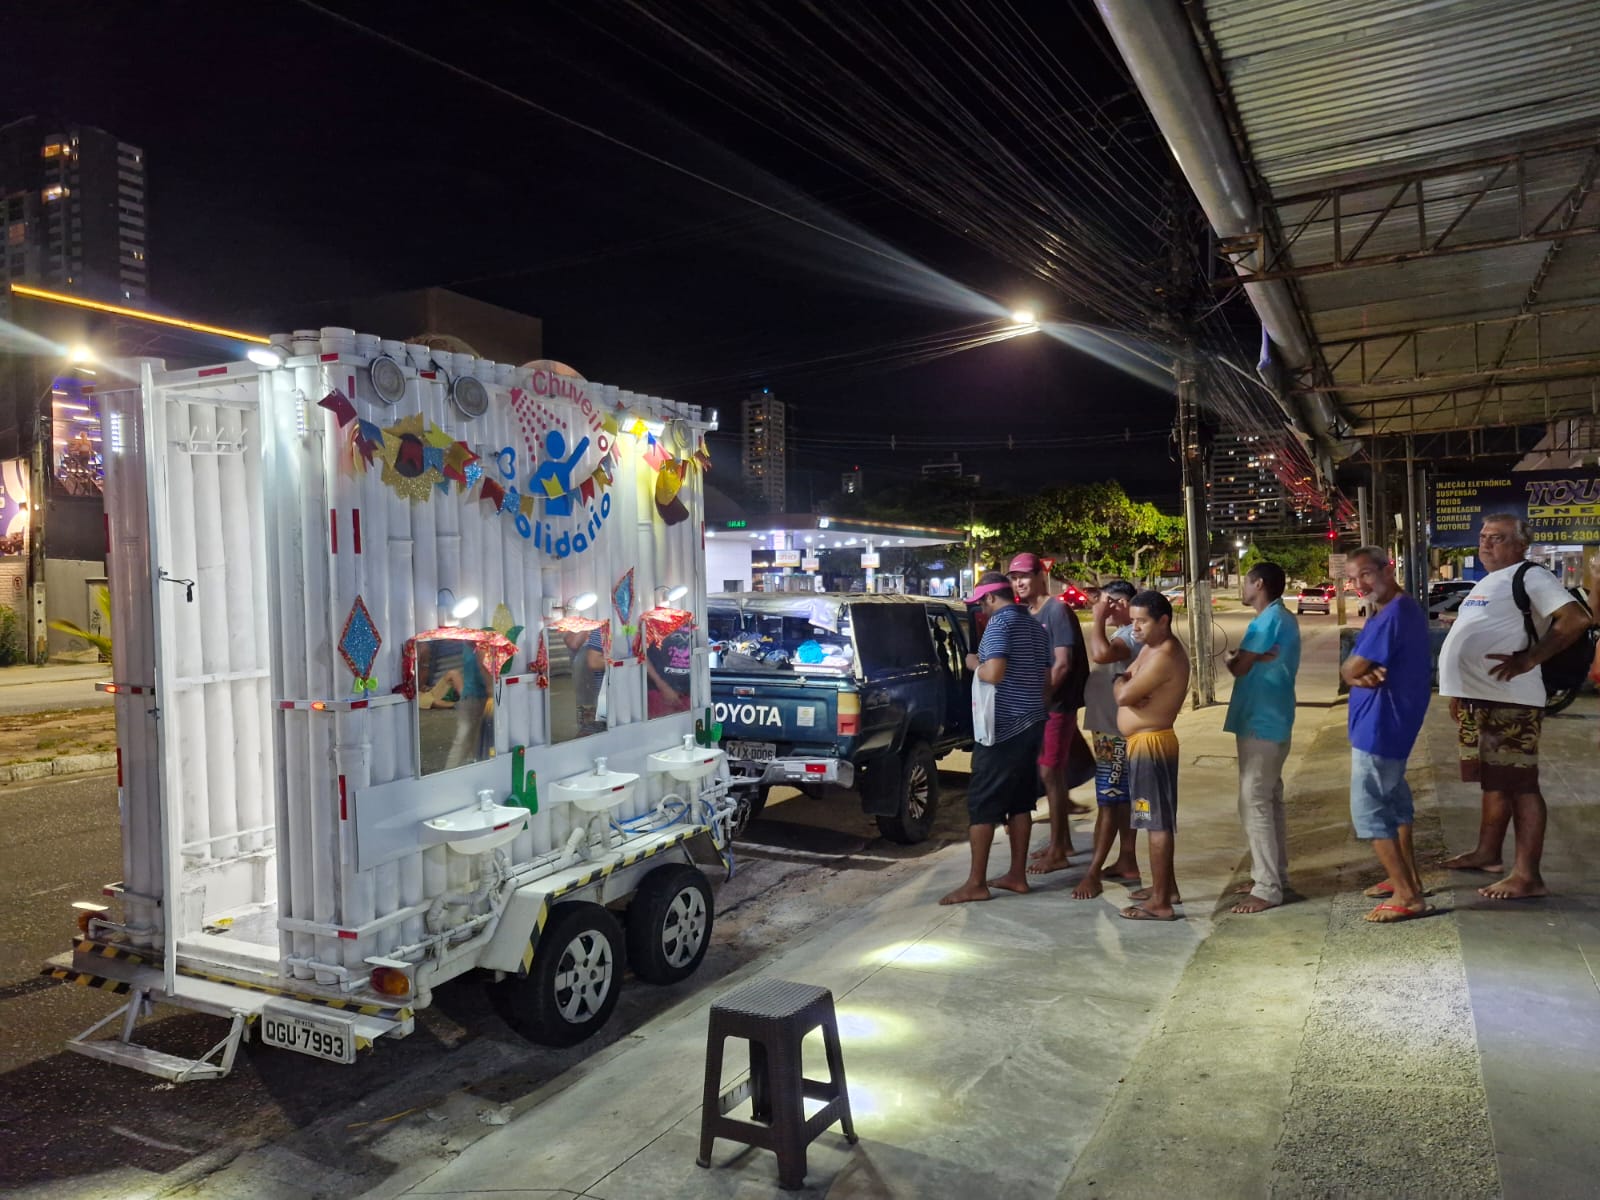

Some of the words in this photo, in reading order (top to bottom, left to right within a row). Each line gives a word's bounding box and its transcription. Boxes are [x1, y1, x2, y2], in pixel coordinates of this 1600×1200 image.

[1436, 489, 1477, 497] SUSPENSÃO
[509, 486, 611, 557] olidário
[1436, 514, 1471, 522] CORREIAS
[1528, 518, 1571, 527] CENTRO
[710, 702, 782, 727] OYOTA
